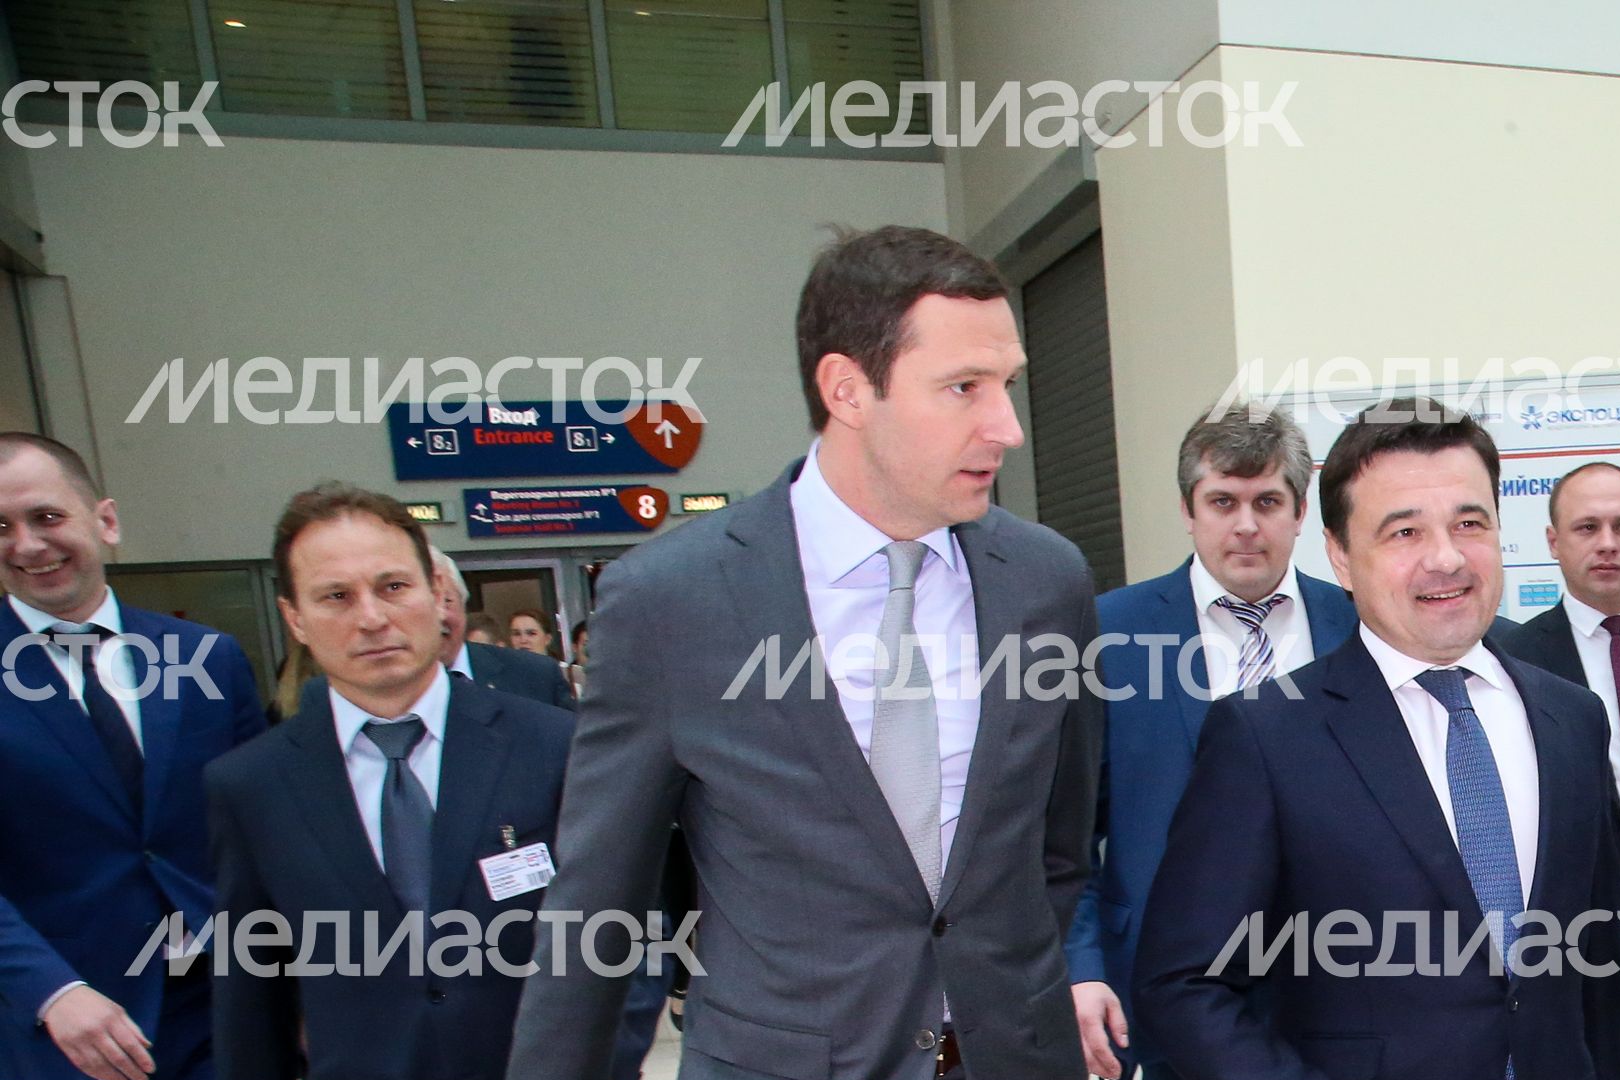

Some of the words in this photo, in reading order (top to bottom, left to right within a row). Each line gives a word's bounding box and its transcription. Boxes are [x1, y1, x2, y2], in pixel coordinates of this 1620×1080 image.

[488, 407, 537, 426] Вход
[474, 428, 553, 445] Entrance
[638, 494, 658, 519] 8
